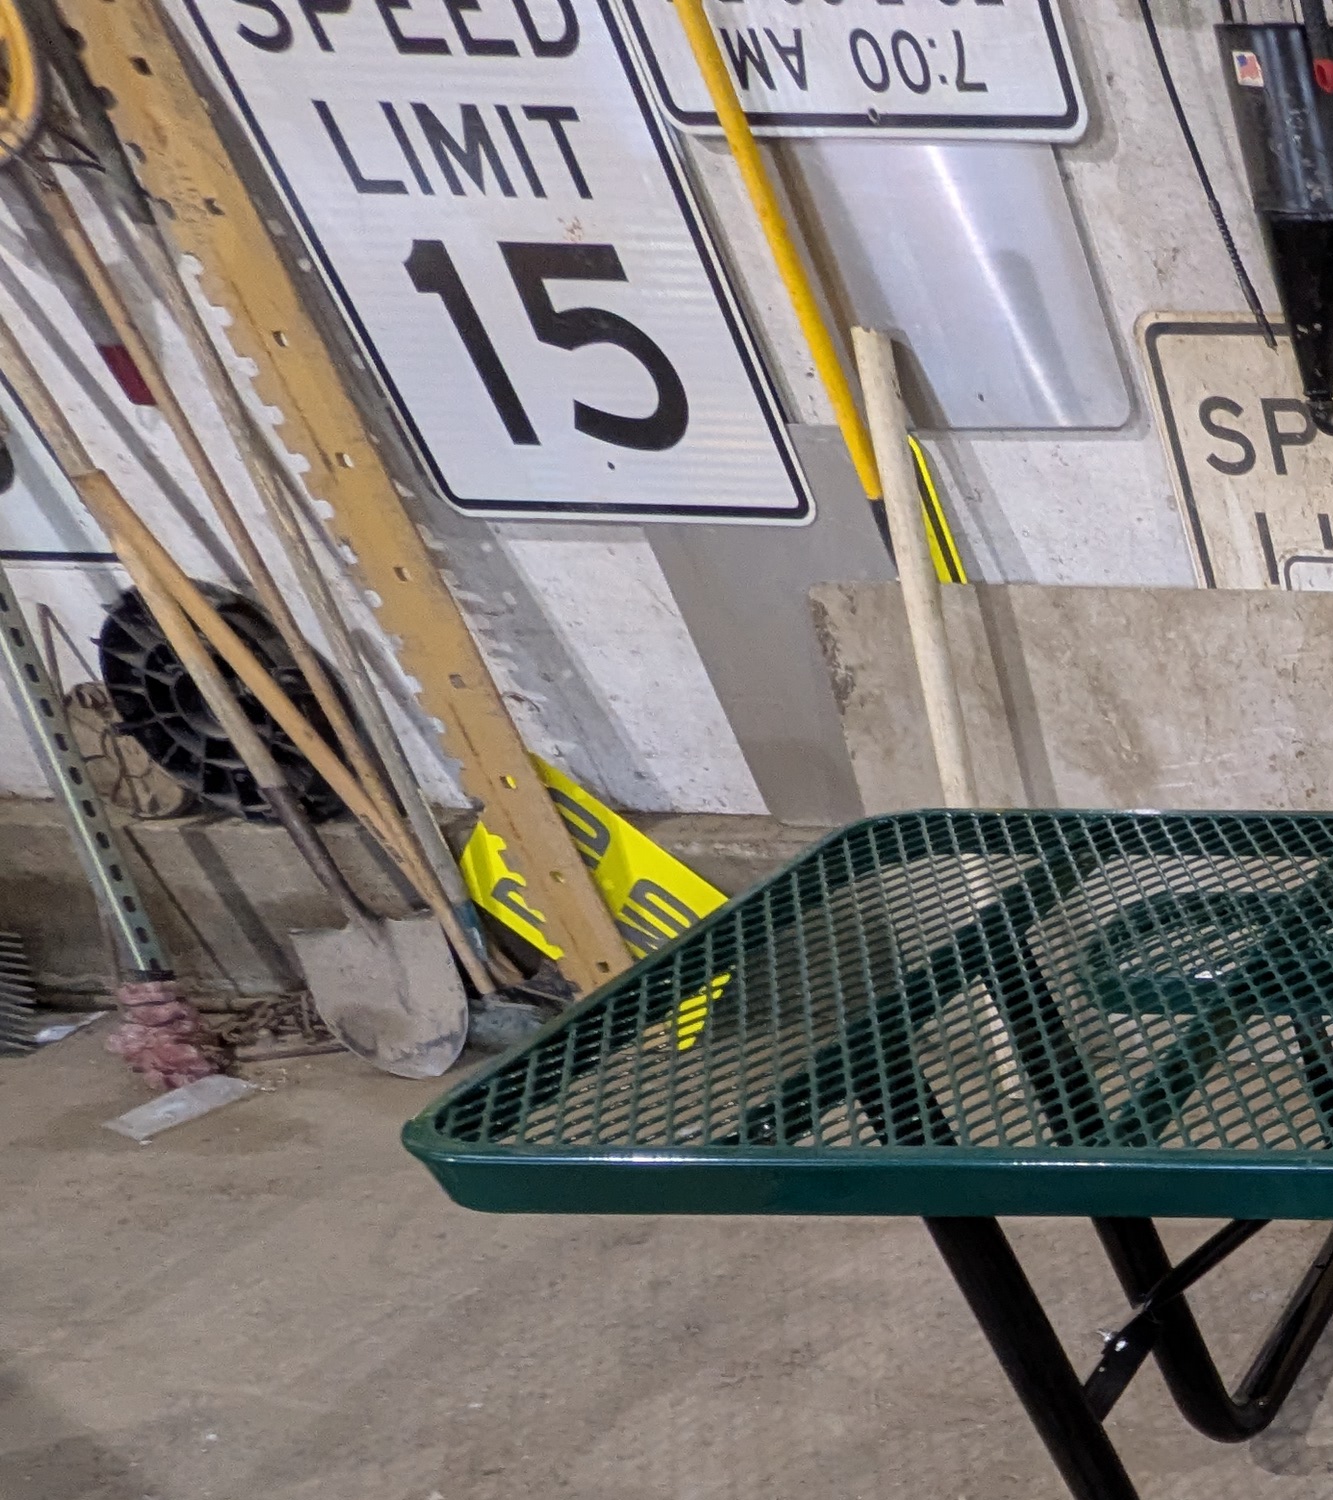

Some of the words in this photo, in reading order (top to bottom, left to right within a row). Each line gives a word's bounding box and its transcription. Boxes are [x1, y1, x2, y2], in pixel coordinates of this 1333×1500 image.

[721, 28, 808, 92] AM
[848, 28, 989, 95] 7:00
[311, 99, 595, 200] LIMIT
[404, 239, 690, 452] 15
